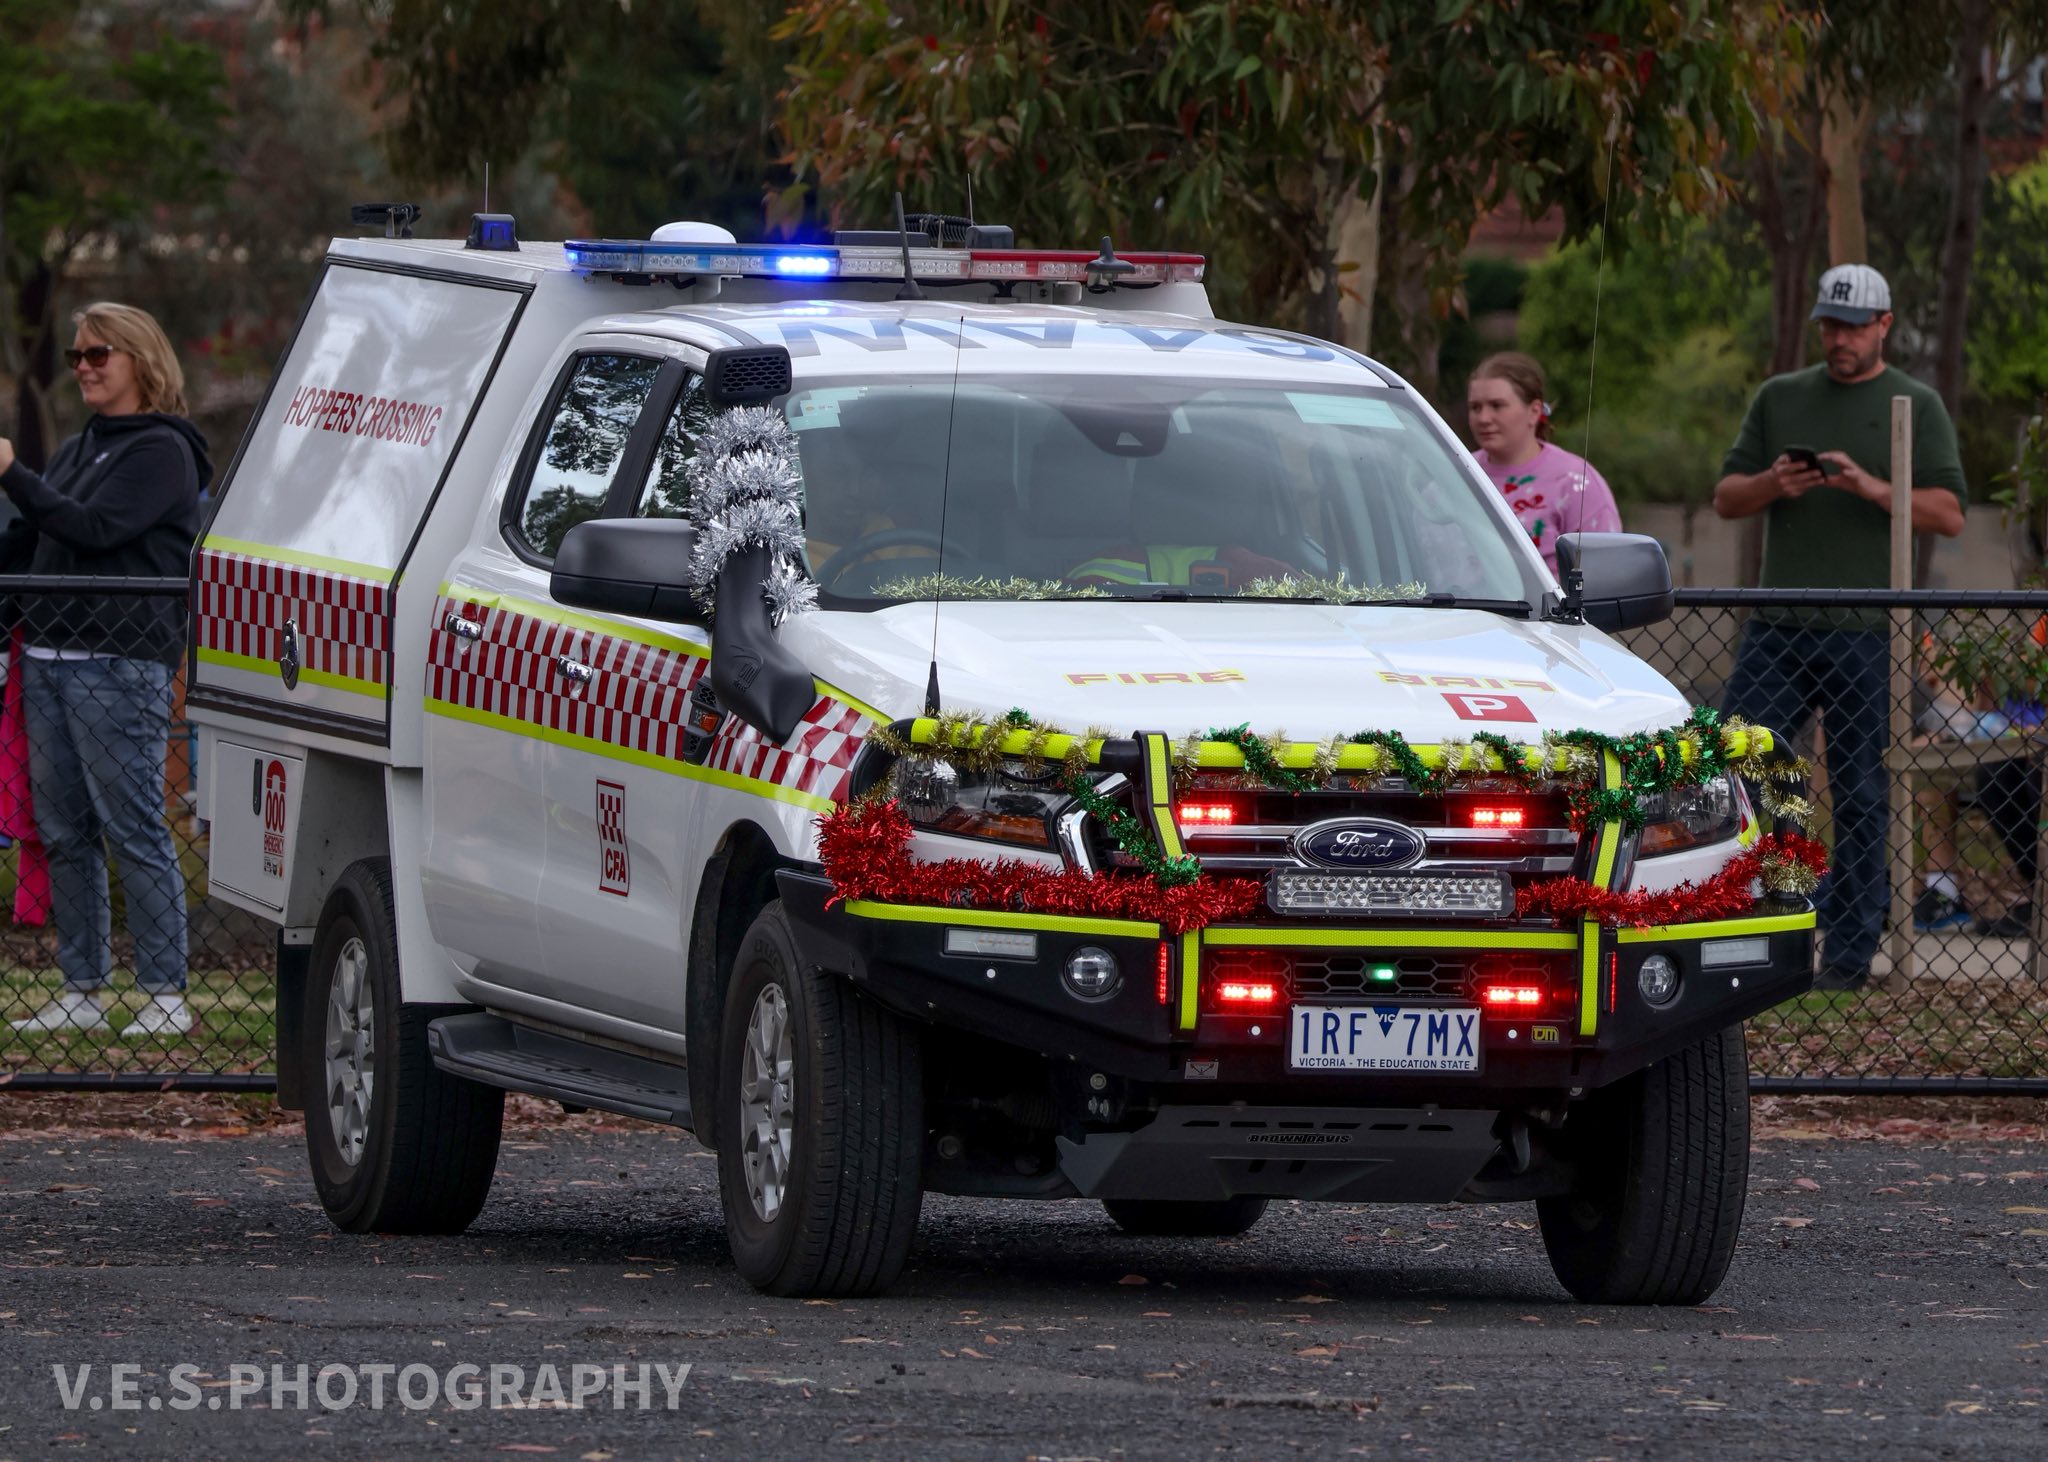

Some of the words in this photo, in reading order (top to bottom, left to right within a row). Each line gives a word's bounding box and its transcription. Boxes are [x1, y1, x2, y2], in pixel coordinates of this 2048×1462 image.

[283, 385, 363, 434] HOPPERS
[355, 396, 443, 447] CROSSING
[1063, 668, 1249, 686] FIRE
[1458, 696, 1508, 716] P
[265, 790, 286, 833] 000
[1329, 831, 1394, 858] Ford
[605, 847, 627, 883] CFA
[1375, 1013, 1396, 1023] VIC
[1300, 1012, 1367, 1055] 1RF
[1403, 1014, 1475, 1057] 7MX
[1299, 1057, 1346, 1068] VICTORIA
[1356, 1058, 1376, 1068] THE
[1379, 1059, 1437, 1069] EDUCATION
[1440, 1060, 1471, 1070] STATE
